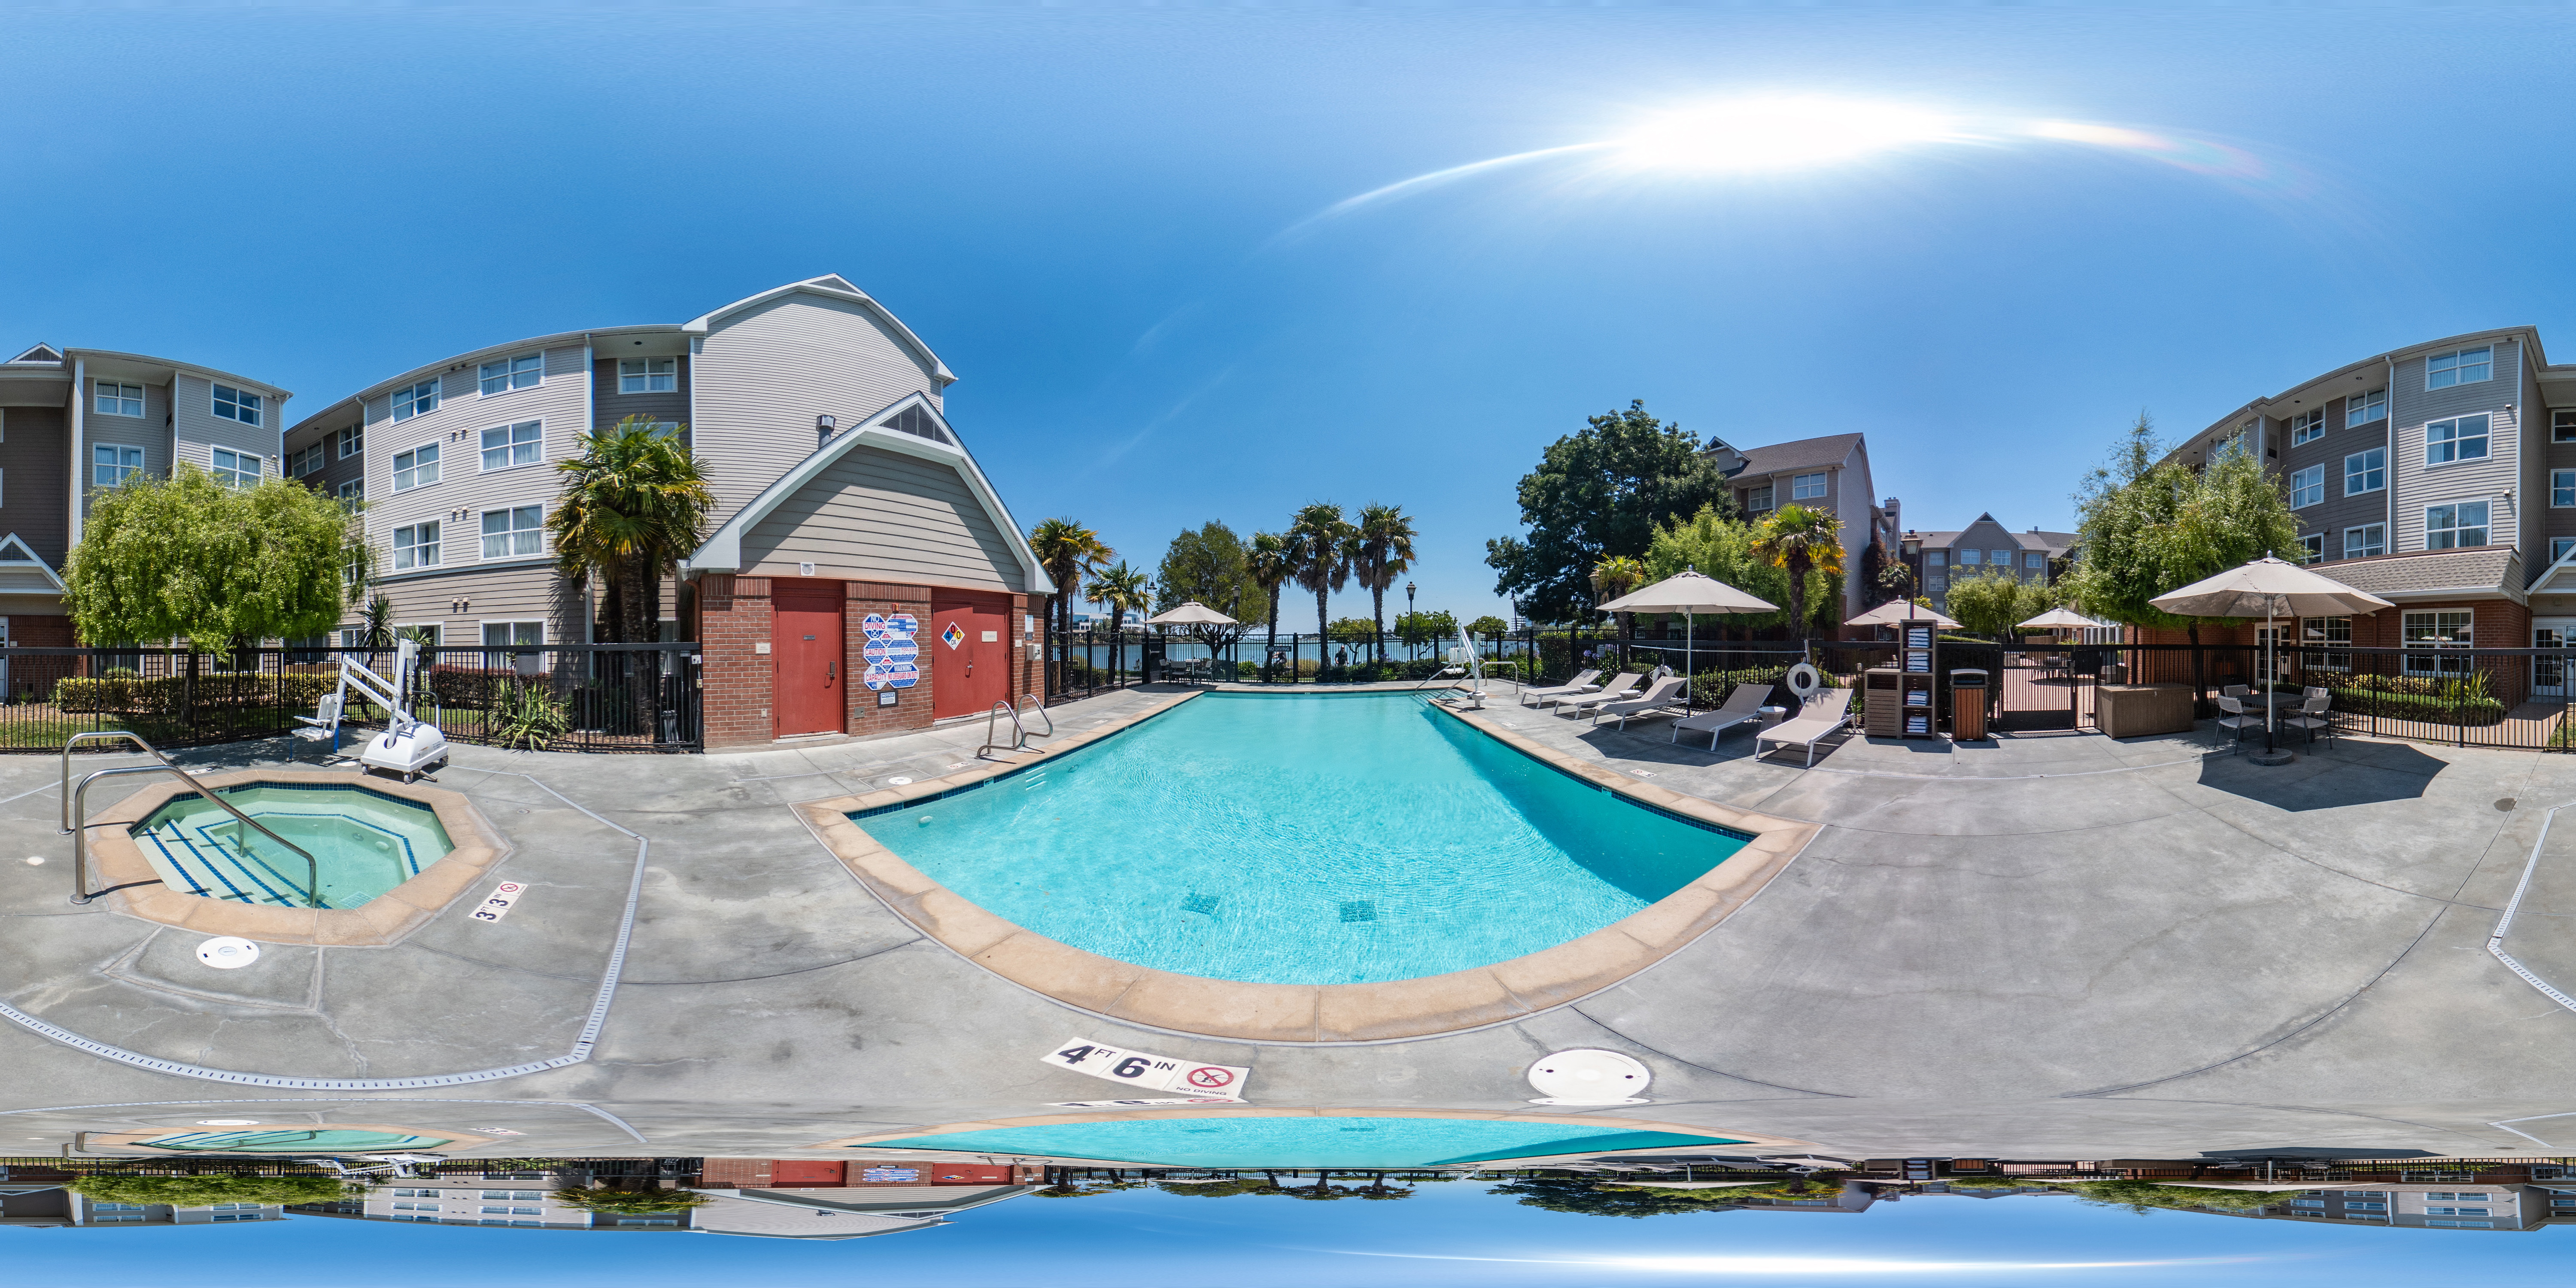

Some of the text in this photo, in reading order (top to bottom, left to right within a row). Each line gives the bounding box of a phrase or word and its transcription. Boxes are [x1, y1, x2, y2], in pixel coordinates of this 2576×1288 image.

[951, 625, 955, 633] 0
[946, 632, 951, 640] 4
[957, 631, 961, 639] 0
[866, 673, 887, 681] CAPACITY
[476, 911, 497, 920] 3
[1058, 1045, 1176, 1078] 4 FT 6 IN
